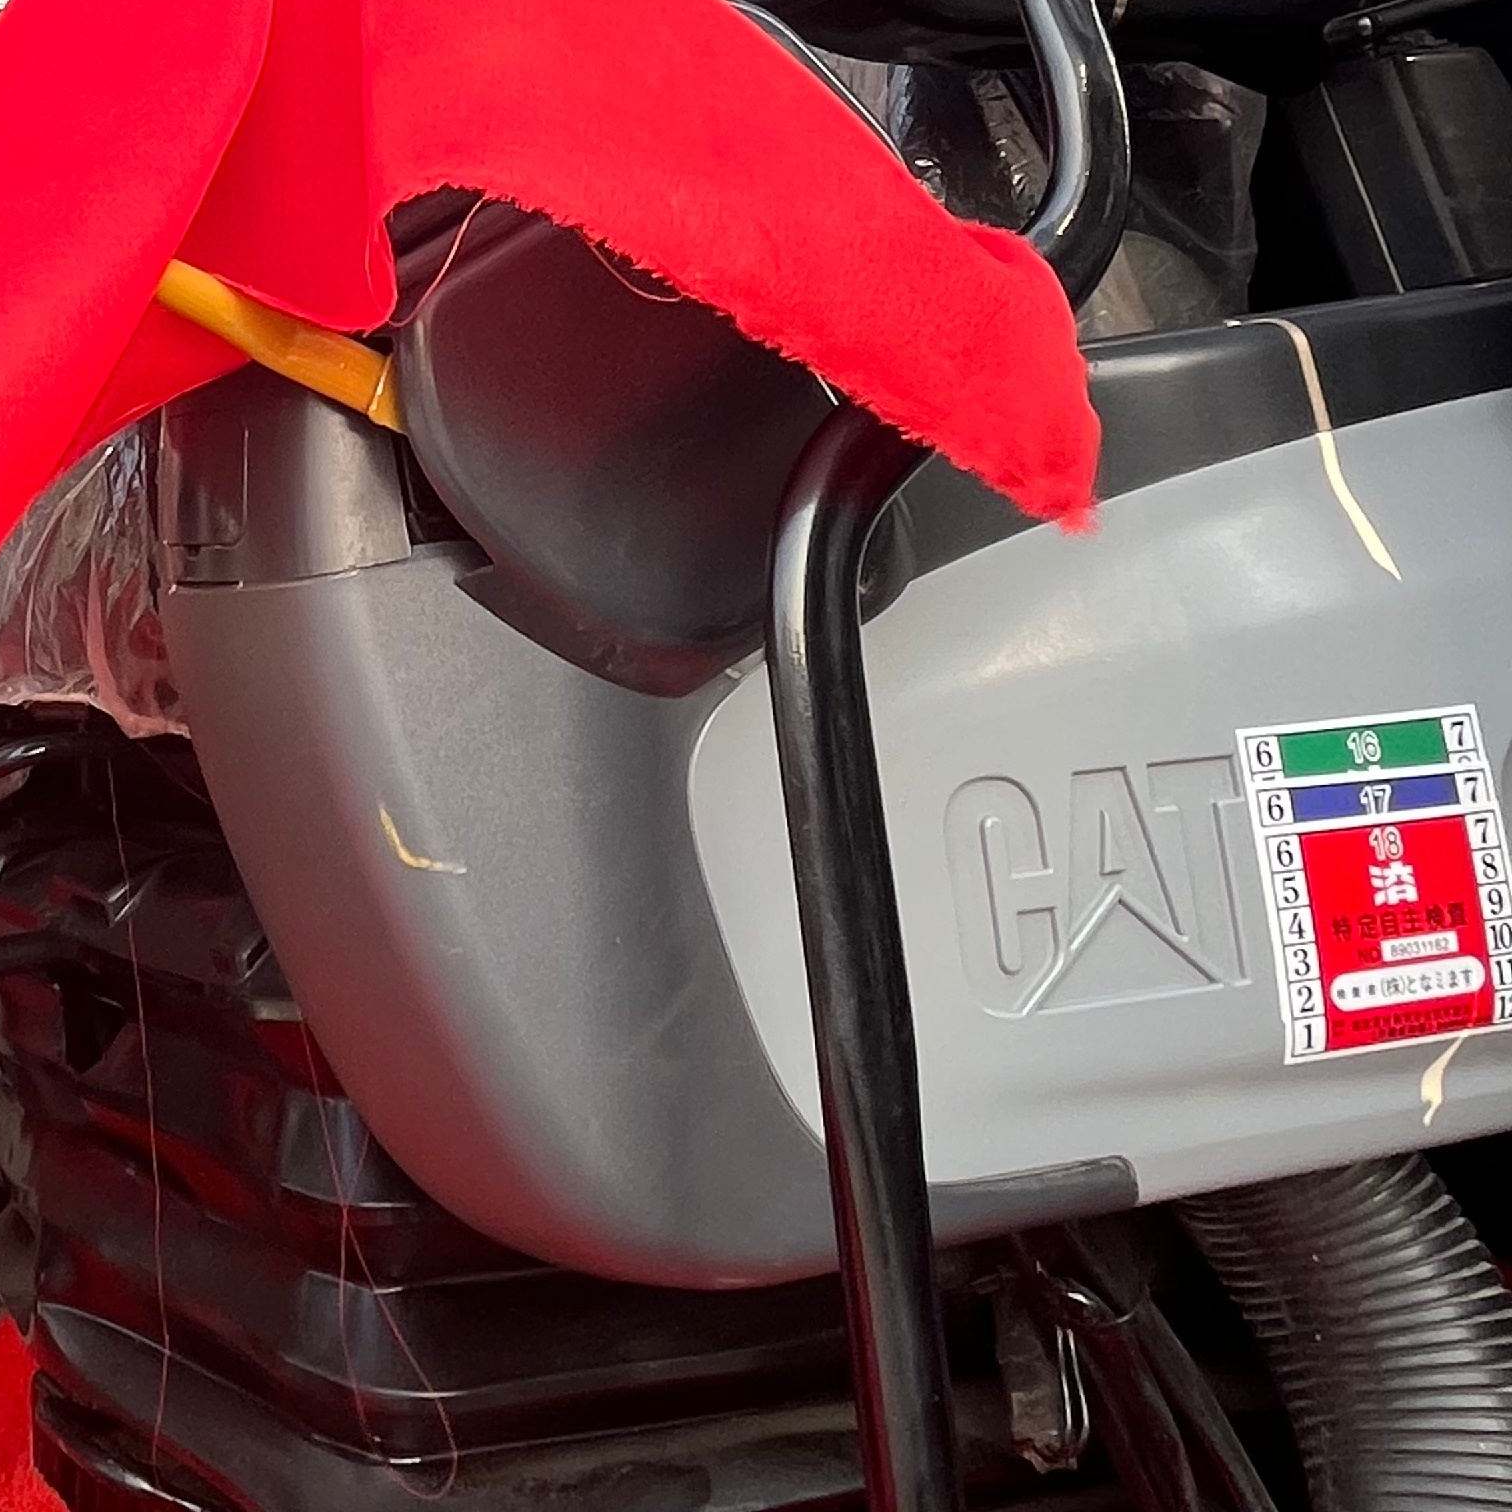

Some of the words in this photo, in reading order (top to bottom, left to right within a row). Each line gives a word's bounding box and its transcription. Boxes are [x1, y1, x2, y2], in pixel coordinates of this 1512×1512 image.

[1346, 730, 1382, 764] 16
[1450, 720, 1465, 747] 7
[1255, 740, 1273, 768] 6
[1359, 784, 1393, 814] 17
[1464, 776, 1479, 803] 7
[1267, 794, 1284, 821] 6
[1368, 825, 1404, 862] 18
[1474, 818, 1489, 844] 7
[1276, 839, 1294, 868] 6
[1482, 852, 1499, 880] 8
[943, 754, 1252, 1019] CAT
[1283, 875, 1300, 904] 5
[1368, 861, 1420, 907] 済
[1487, 888, 1504, 916] 9
[1288, 912, 1306, 940] 4
[1489, 922, 1512, 950] 10
[1293, 948, 1311, 977] 3
[1297, 984, 1316, 1014] 2
[1499, 995, 1512, 1020] 1
[1304, 1023, 1315, 1050] 1
